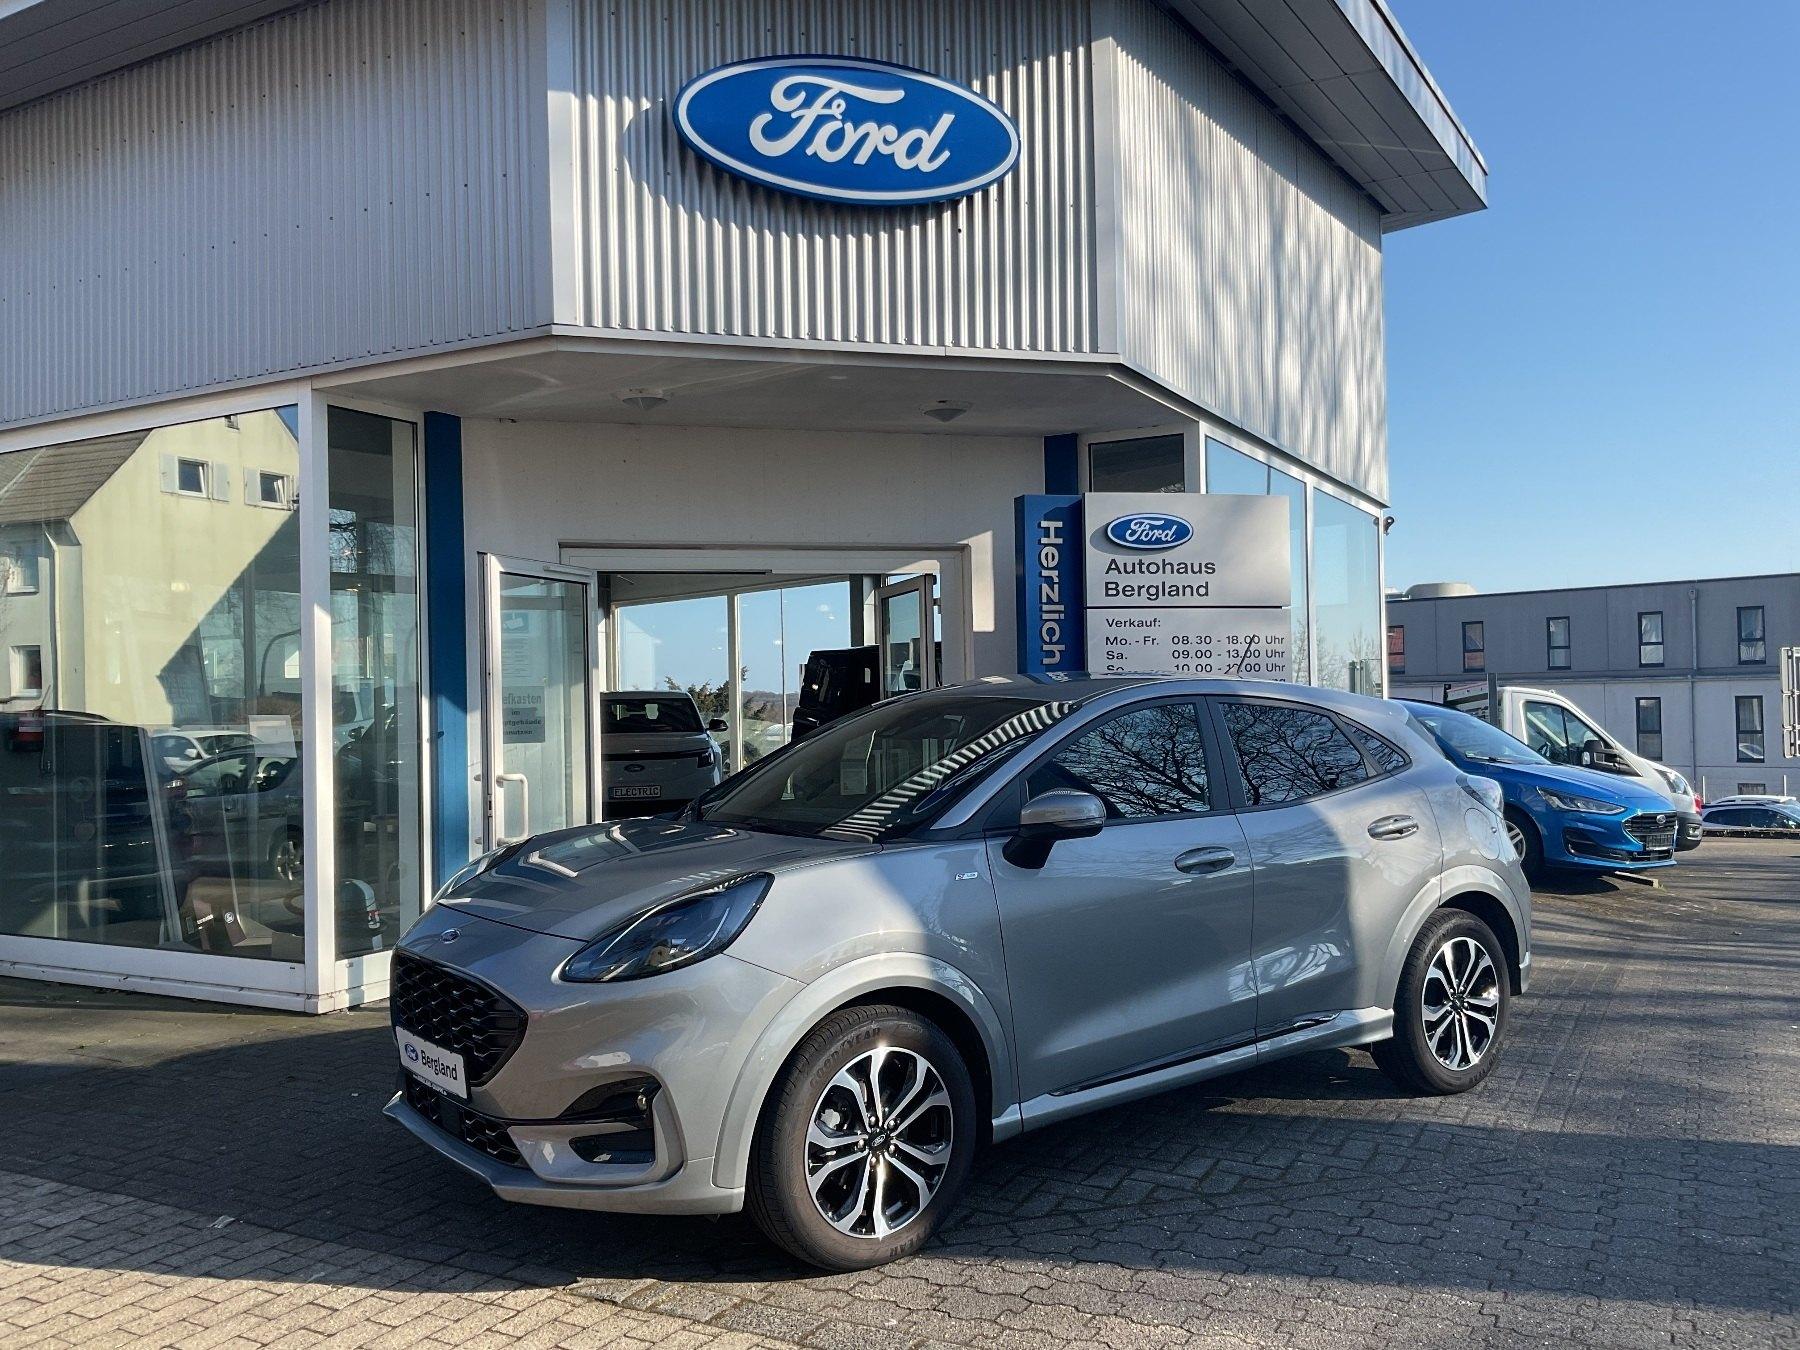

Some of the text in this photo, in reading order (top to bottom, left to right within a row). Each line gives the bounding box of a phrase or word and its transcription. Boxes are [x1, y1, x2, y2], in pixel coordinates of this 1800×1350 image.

[749, 75, 955, 172] Ford
[1125, 519, 1178, 542] Ford
[1105, 558, 1216, 575] Autohaus
[1040, 520, 1066, 665] Herzlich
[1104, 581, 1209, 601] Bergland
[1105, 617, 1161, 628] Verkauf:
[1171, 635, 1212, 645] 08.30
[1226, 635, 1261, 645] 18.00
[1265, 635, 1285, 645] Uhr
[1106, 650, 1128, 660] Sa.
[1171, 649, 1213, 659] 09.00
[1226, 649, 1261, 659] 13.00
[1265, 649, 1285, 659] Uhr
[1173, 663, 1213, 673] 1000
[1265, 662, 1286, 672] Uhr
[614, 787, 660, 797] ELECTRIC
[420, 1049, 458, 1081] Bergland
